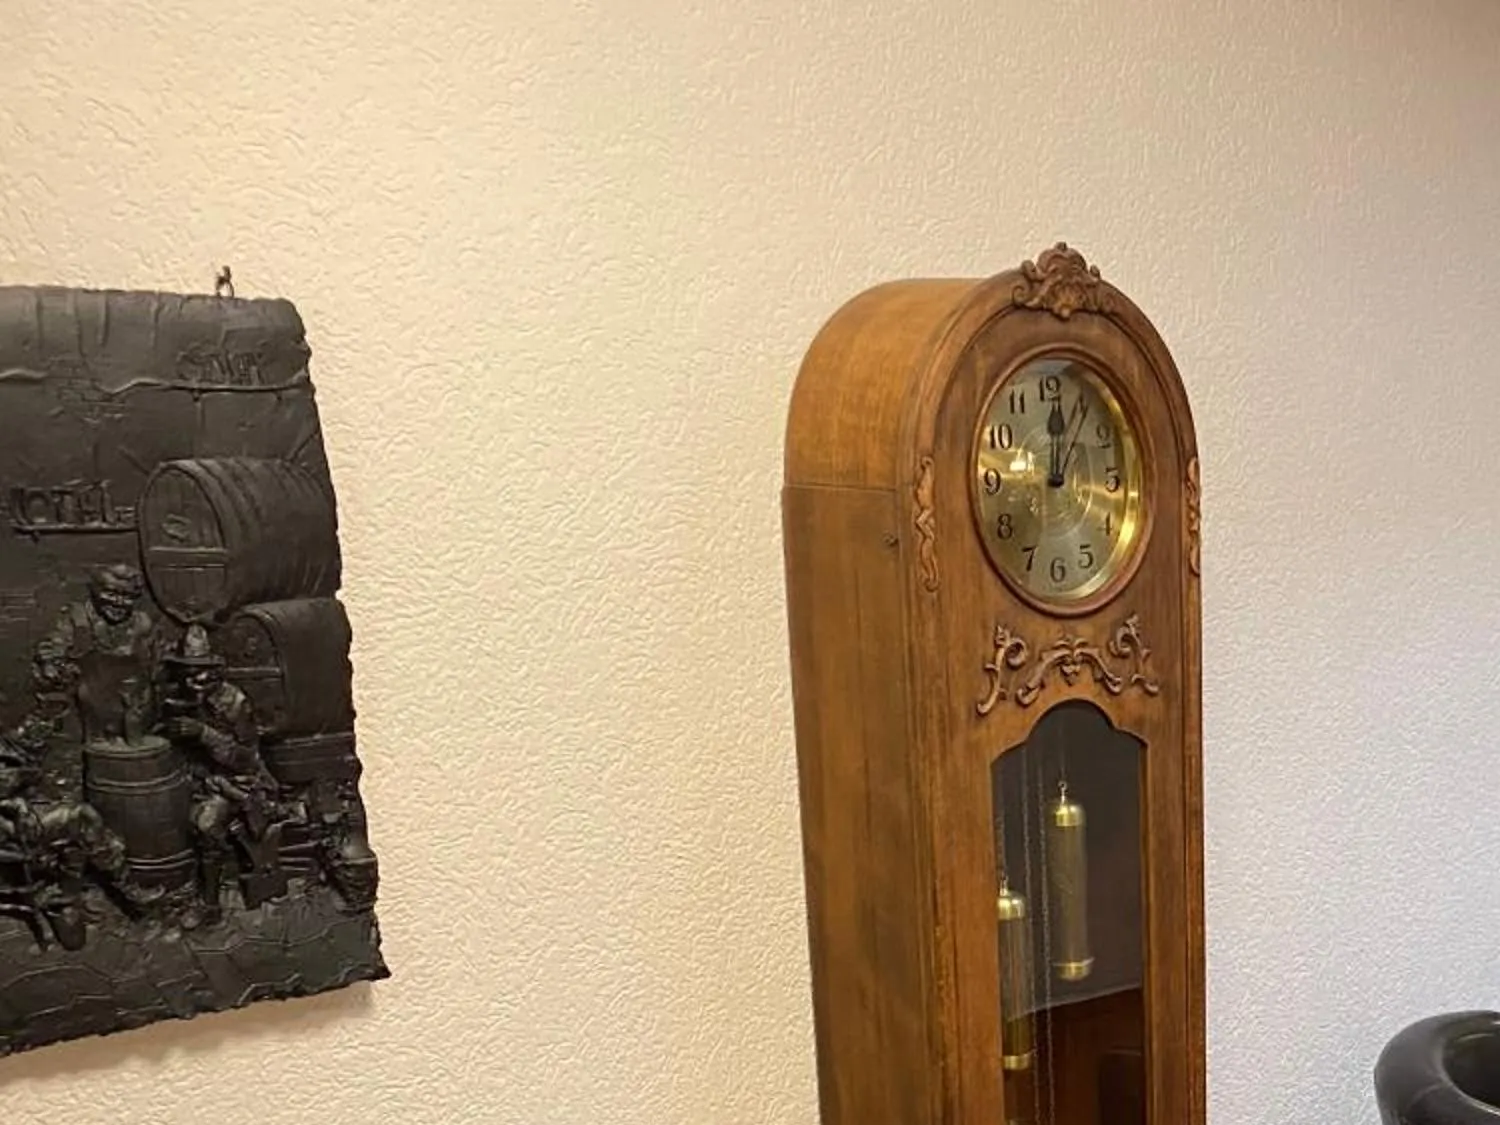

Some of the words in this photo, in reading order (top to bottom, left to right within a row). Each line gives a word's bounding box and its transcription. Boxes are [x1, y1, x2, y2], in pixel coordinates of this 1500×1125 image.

[1039, 375, 1062, 401] 12
[1009, 390, 1025, 414] 11
[990, 423, 1014, 449] 10
[1096, 425, 1110, 449] 2
[984, 468, 1001, 494] 9
[1105, 466, 1120, 492] 3
[997, 513, 1013, 540] 8
[1098, 512, 1113, 536] 4
[1022, 546, 1037, 571] 7
[1080, 544, 1094, 568] 5
[1050, 557, 1066, 582] 6
